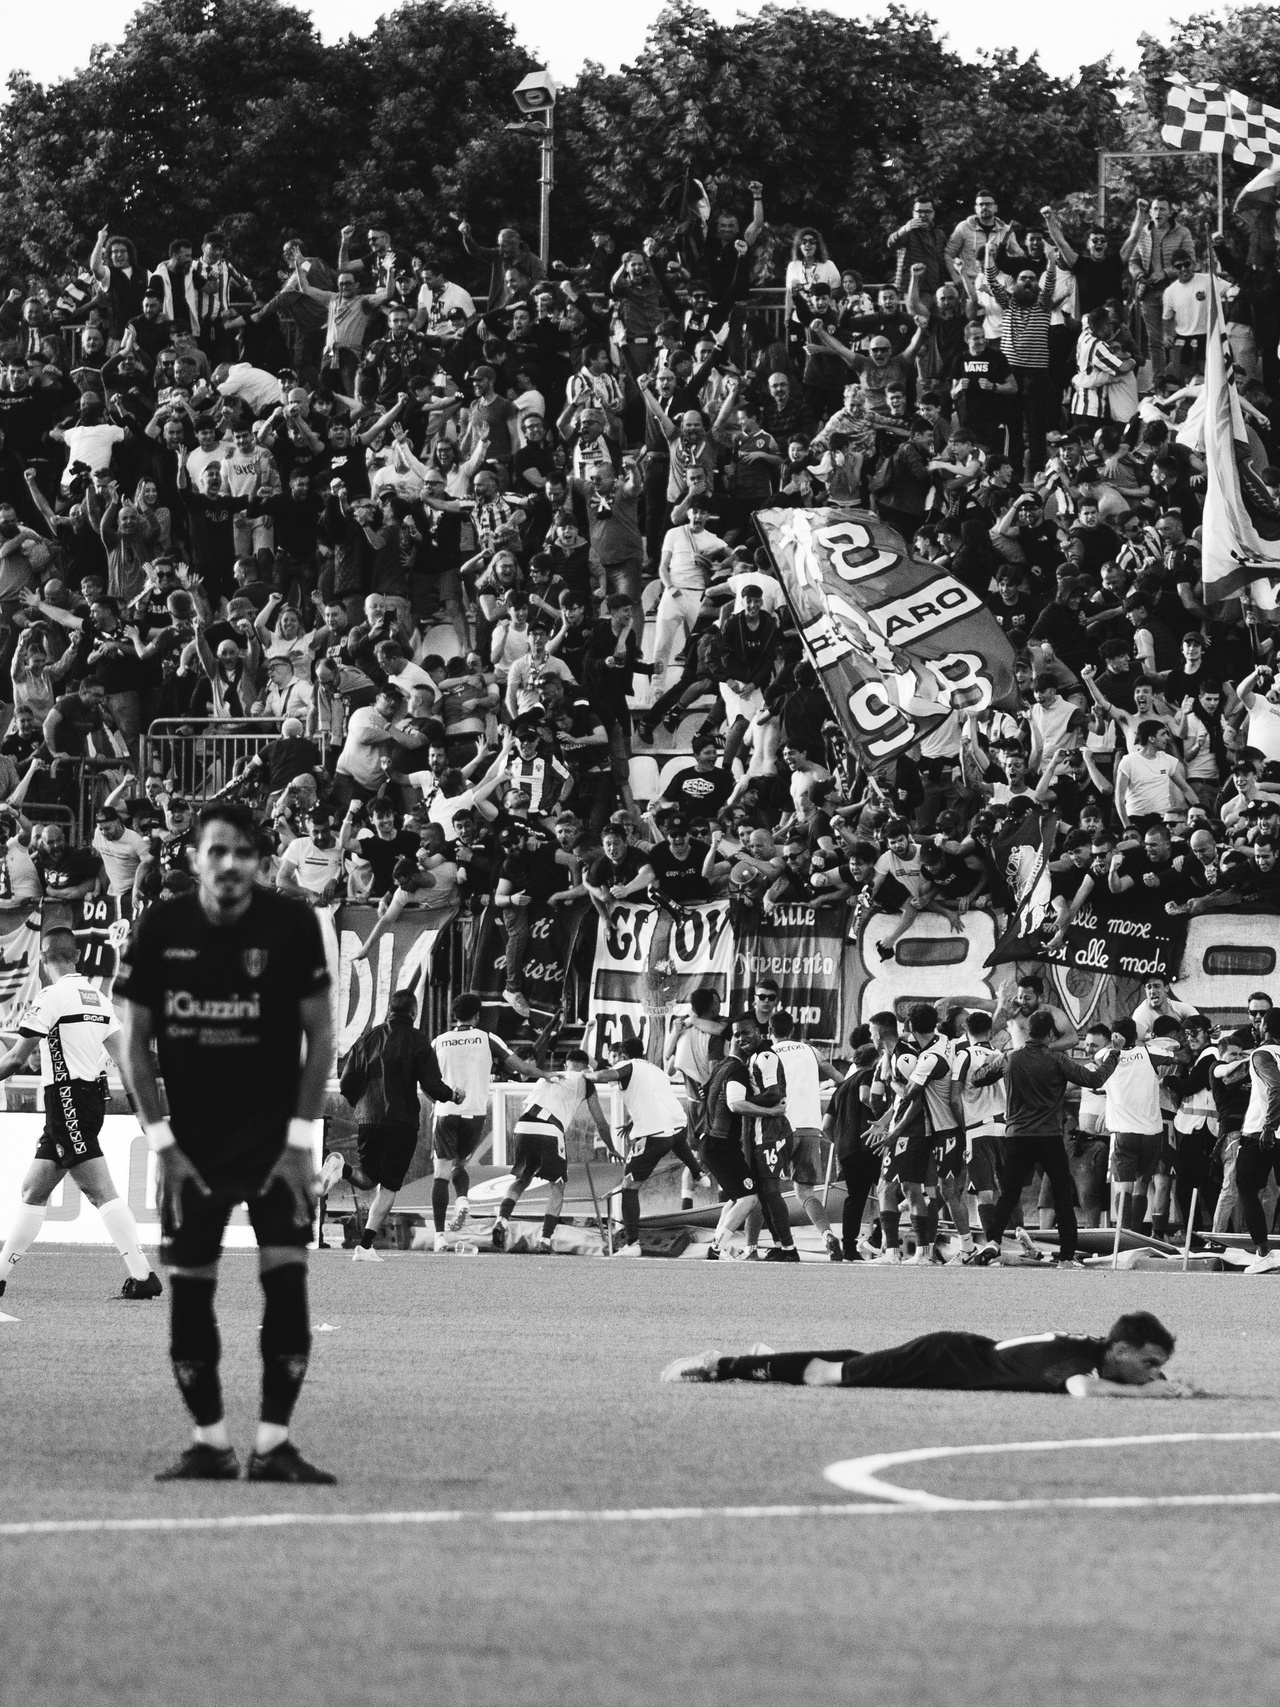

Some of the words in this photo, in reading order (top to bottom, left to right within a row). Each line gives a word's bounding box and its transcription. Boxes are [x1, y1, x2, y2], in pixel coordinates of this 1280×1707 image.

[964, 361, 990, 373] VANS
[761, 905, 815, 927] ille
[1075, 938, 1110, 969] alle
[441, 1036, 482, 1048] macron
[775, 1044, 806, 1054] acron
[763, 1147, 778, 1166] 16
